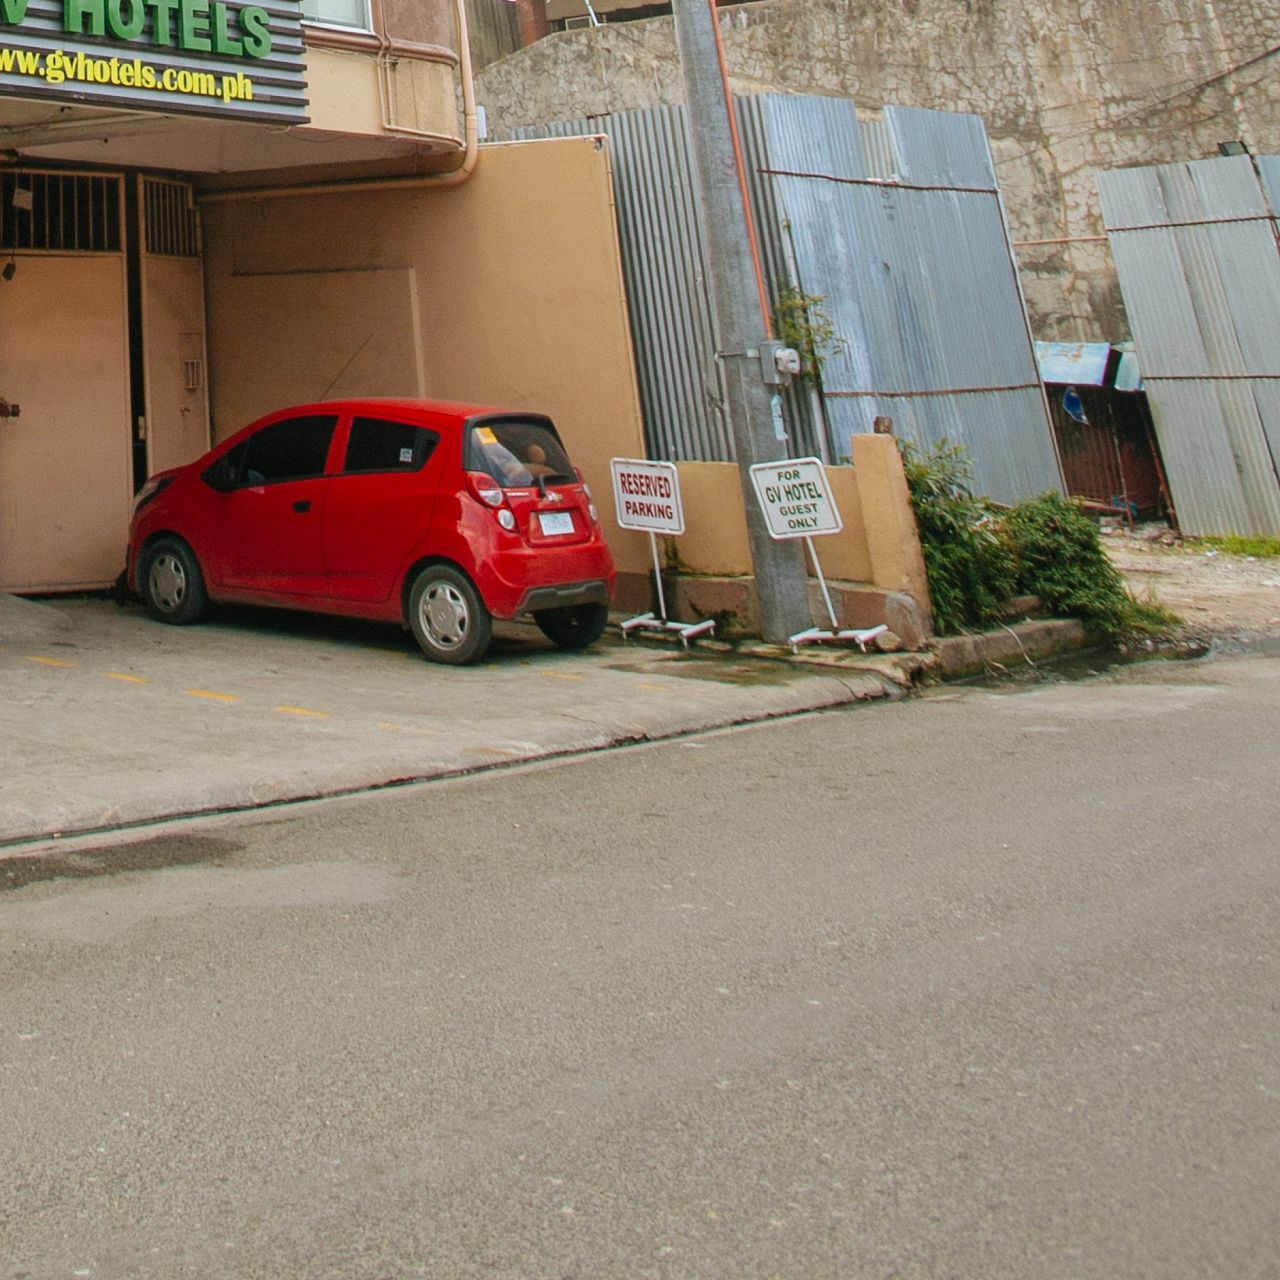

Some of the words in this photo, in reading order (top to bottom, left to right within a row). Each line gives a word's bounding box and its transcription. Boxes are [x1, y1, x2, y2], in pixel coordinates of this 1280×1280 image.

[777, 469, 800, 481] FOR
[619, 472, 671, 498] RESERVED
[765, 485, 782, 503] GV
[783, 481, 823, 502] HOTEL
[625, 500, 673, 520] PARKING
[779, 503, 817, 516] GUEST
[788, 517, 818, 529] ONLY
